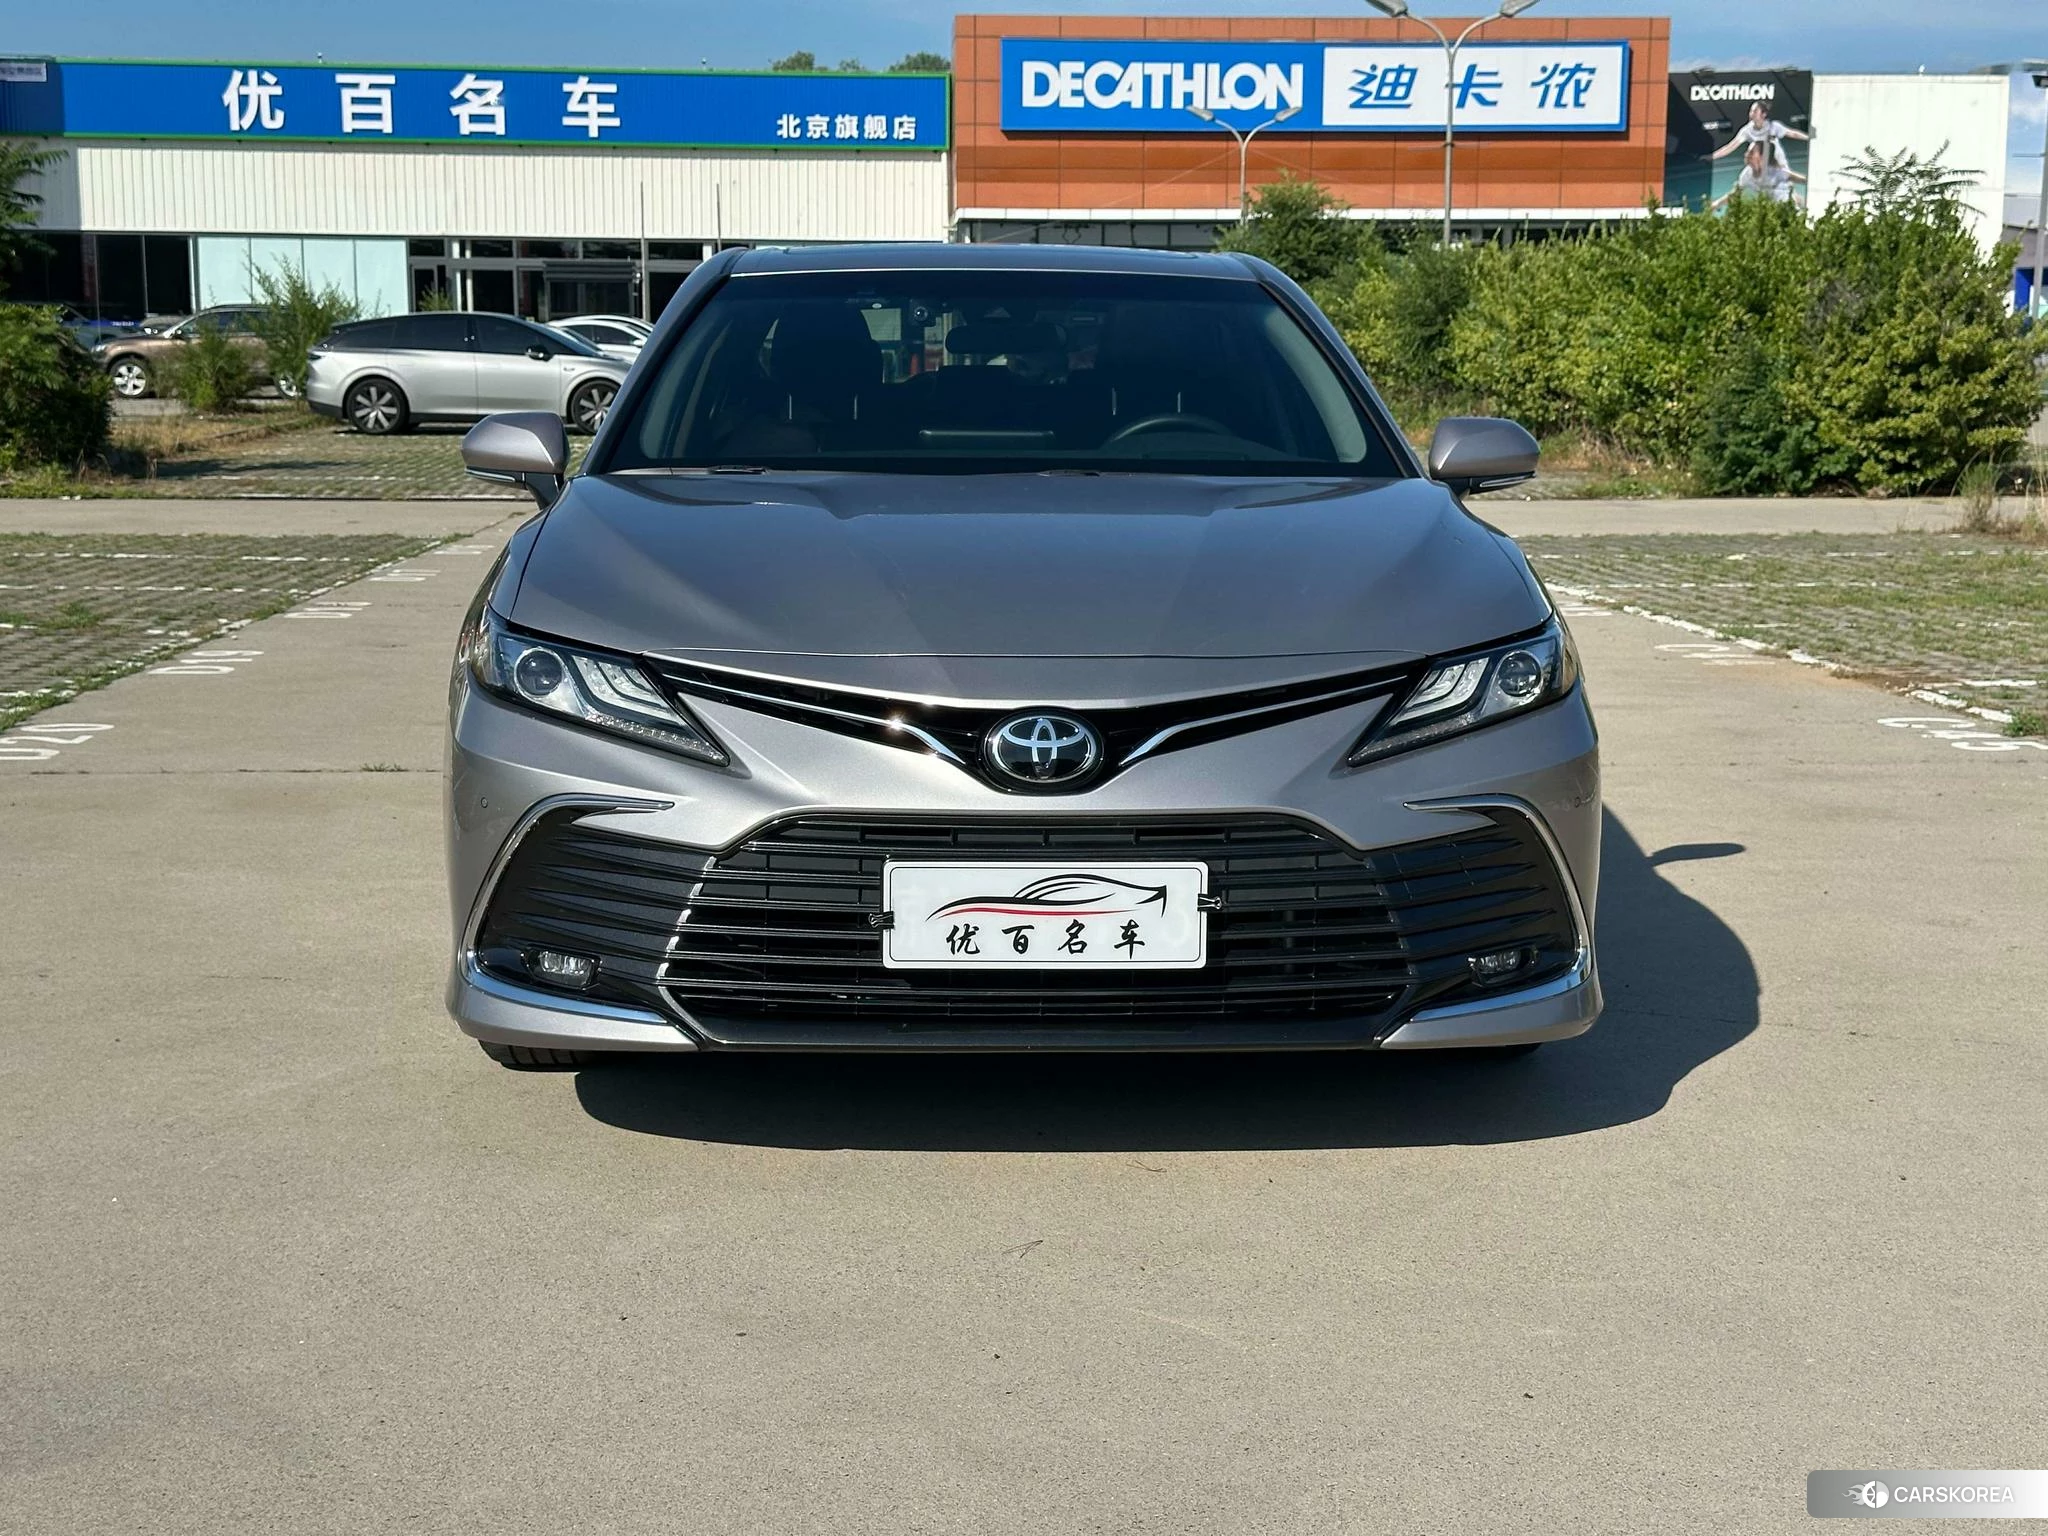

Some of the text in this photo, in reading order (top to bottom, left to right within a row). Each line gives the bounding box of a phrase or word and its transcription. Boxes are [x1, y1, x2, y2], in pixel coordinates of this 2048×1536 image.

[221, 69, 621, 138] 优百名车
[1022, 60, 1304, 110] DECATHLON
[1348, 63, 1597, 109] 迪卡侬
[1690, 83, 1775, 101] DECATHLON
[776, 113, 916, 140] 北京旗舰店
[945, 917, 1146, 960] 优百名车
